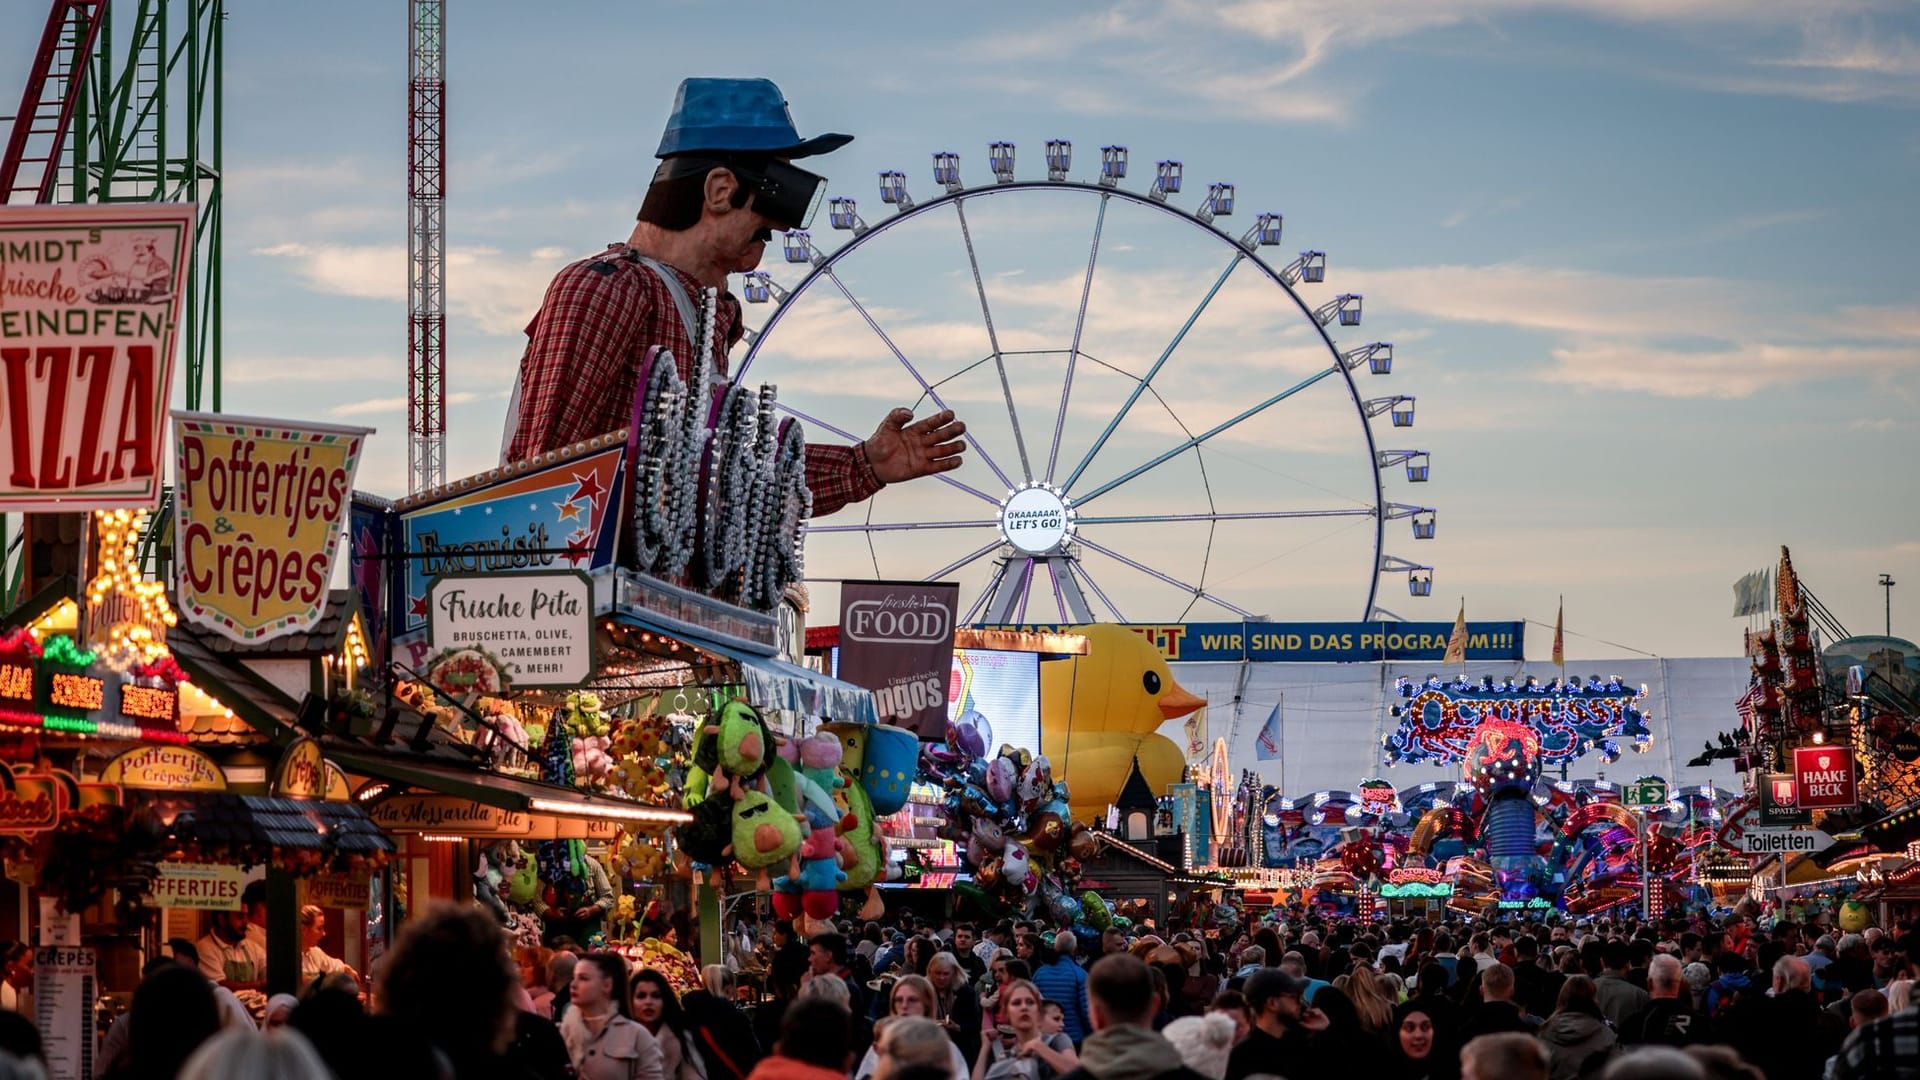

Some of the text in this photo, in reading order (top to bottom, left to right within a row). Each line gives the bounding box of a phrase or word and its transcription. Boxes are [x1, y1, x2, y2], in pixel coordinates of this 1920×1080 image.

[0, 345, 155, 489] IZZA
[183, 436, 347, 538] Poffertjes
[214, 516, 235, 535] &
[1010, 518, 1062, 530] LET'S GO!
[417, 522, 554, 577] Exquisit
[185, 522, 329, 616] Crêpes
[439, 588, 582, 623] Frische Pita
[852, 610, 942, 638] FOOD
[453, 629, 573, 642] BRUSCHETTA, OLIVE,
[1200, 634, 1243, 650] WIR
[1251, 633, 1302, 650] SIND
[1310, 633, 1353, 650] DAS
[1360, 633, 1514, 650] PROGRAM!!!
[501, 646, 572, 657] CAMEMBERT
[514, 663, 563, 674] & MEHR!
[874, 677, 943, 719] ngos
[119, 748, 215, 783] Poffertjes
[143, 768, 190, 785] Crêpes
[1803, 770, 1847, 784] HAAKE
[1809, 783, 1843, 797] BECK
[1745, 834, 1815, 852] Toiletten
[151, 878, 238, 898] FFERTJES
